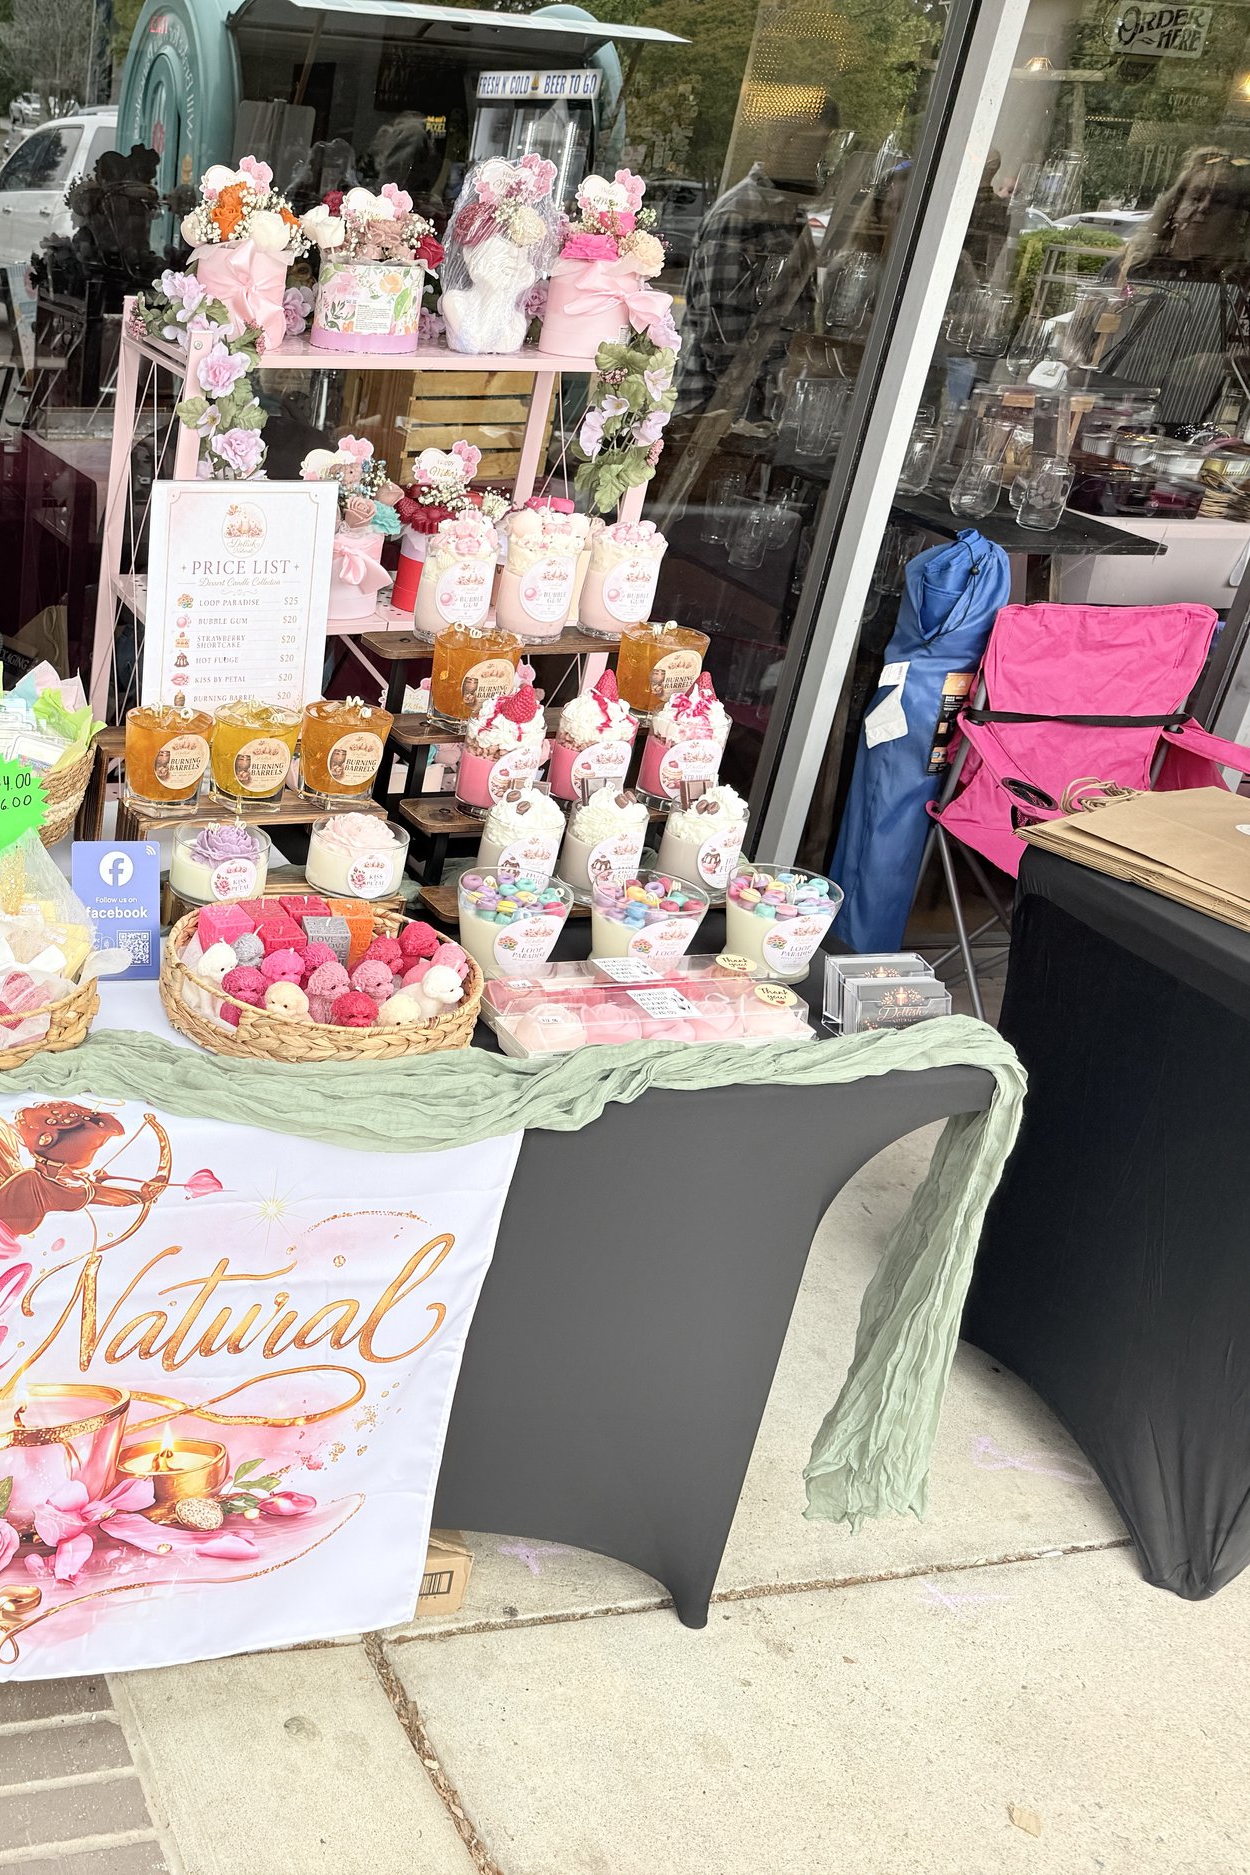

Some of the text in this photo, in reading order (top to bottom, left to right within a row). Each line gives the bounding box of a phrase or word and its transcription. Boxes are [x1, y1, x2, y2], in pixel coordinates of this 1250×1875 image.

[1118, 6, 1205, 46] ORDER
[1157, 29, 1202, 52] HERE
[478, 76, 501, 95] FRESH
[510, 75, 530, 94] COLD
[544, 75, 568, 94] BEER
[569, 75, 581, 94] TO
[582, 74, 598, 94] GO
[191, 559, 291, 575] PRICE LIST
[197, 576, 281, 588] Dessert Candle Collection
[199, 596, 299, 607] LOOP PARADISE $25
[198, 615, 297, 625] BUBBLE GUM $20
[197, 634, 246, 642] STRAWBERRY
[281, 635, 296, 644] $20
[196, 641, 241, 649] SHORTCAKE
[196, 656, 211, 664] HOT
[280, 654, 295, 663] $20
[195, 676, 211, 684] KISS
[278, 673, 293, 682] $20
[665, 675, 695, 685] BURNING
[478, 685, 508, 693] BURNING
[664, 681, 693, 690] BARRELS
[193, 694, 227, 703] BURNING
[277, 691, 292, 700] $20
[170, 758, 201, 766] BURNING
[251, 762, 284, 771] BURNING
[345, 758, 377, 767] BURNING
[169, 763, 201, 772] BARRELS
[250, 768, 283, 777] BARRELS
[344, 764, 375, 773] BARRELS
[86, 906, 148, 919] facebook
[722, 956, 748, 966] Thank
[759, 987, 788, 997] Thank
[18, 1233, 448, 1380] Natural
